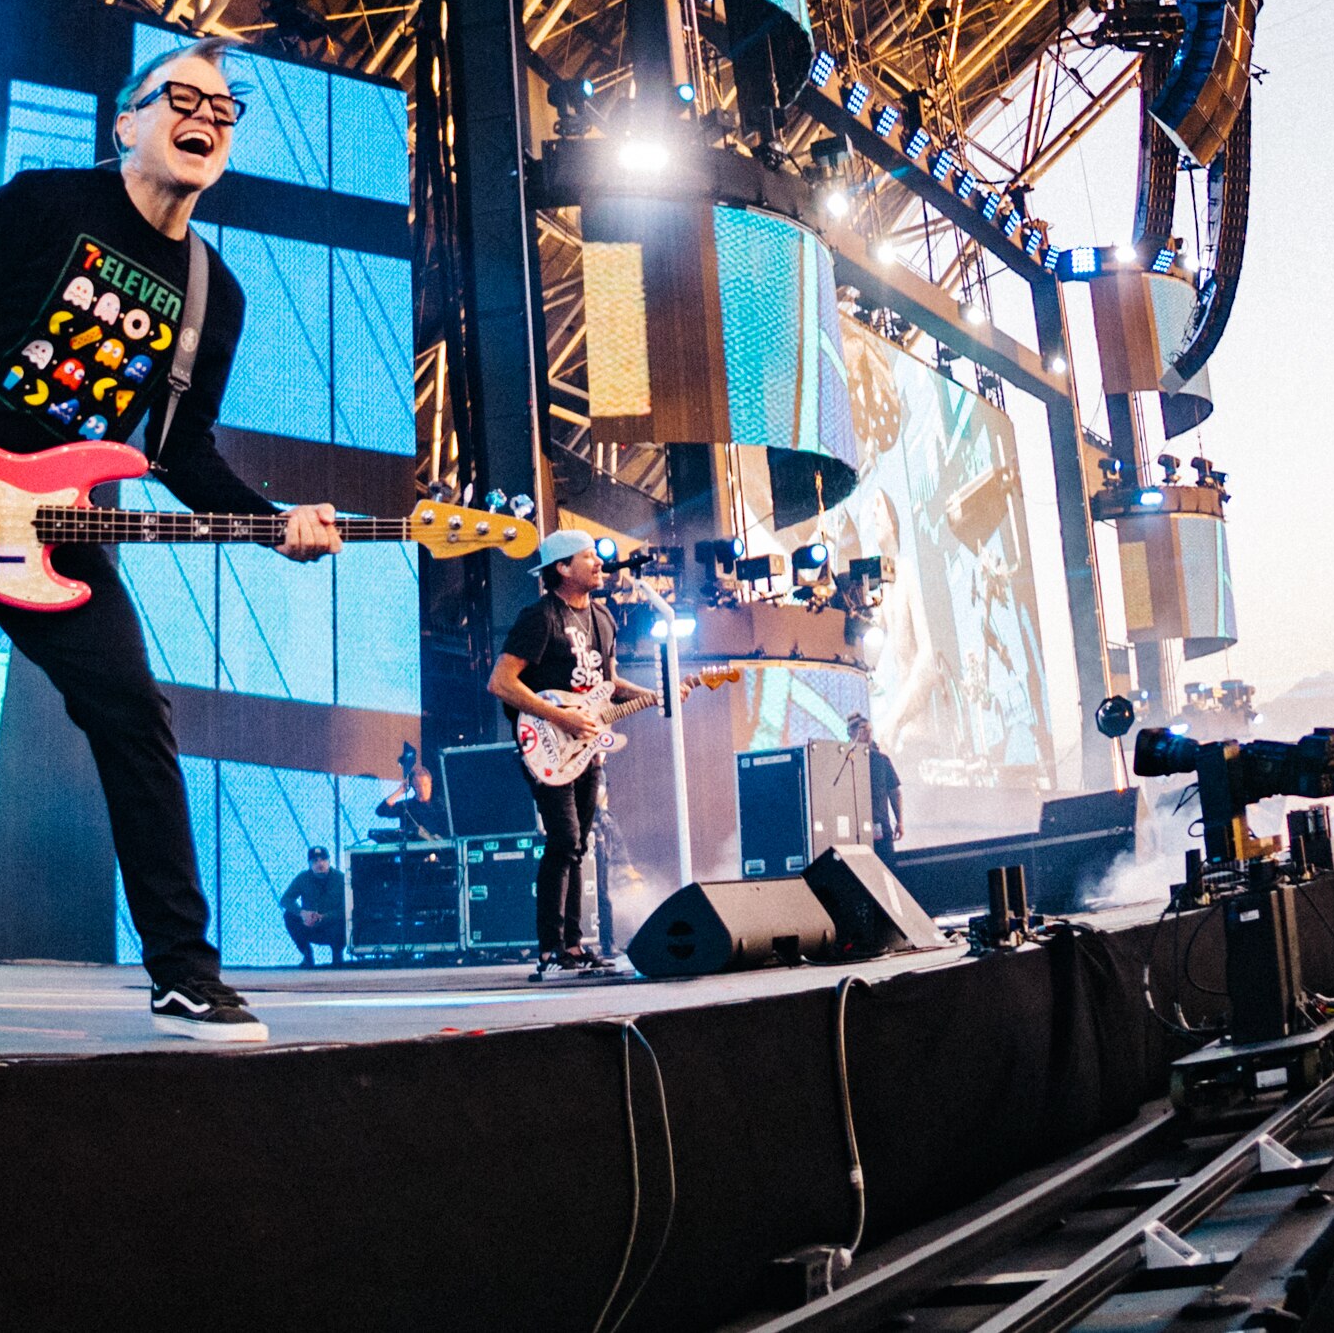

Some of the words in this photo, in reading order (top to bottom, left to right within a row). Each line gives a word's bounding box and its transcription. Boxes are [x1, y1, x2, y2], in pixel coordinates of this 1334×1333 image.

[564, 626, 587, 648] To
[571, 646, 603, 669] The
[570, 665, 604, 688] Sta
